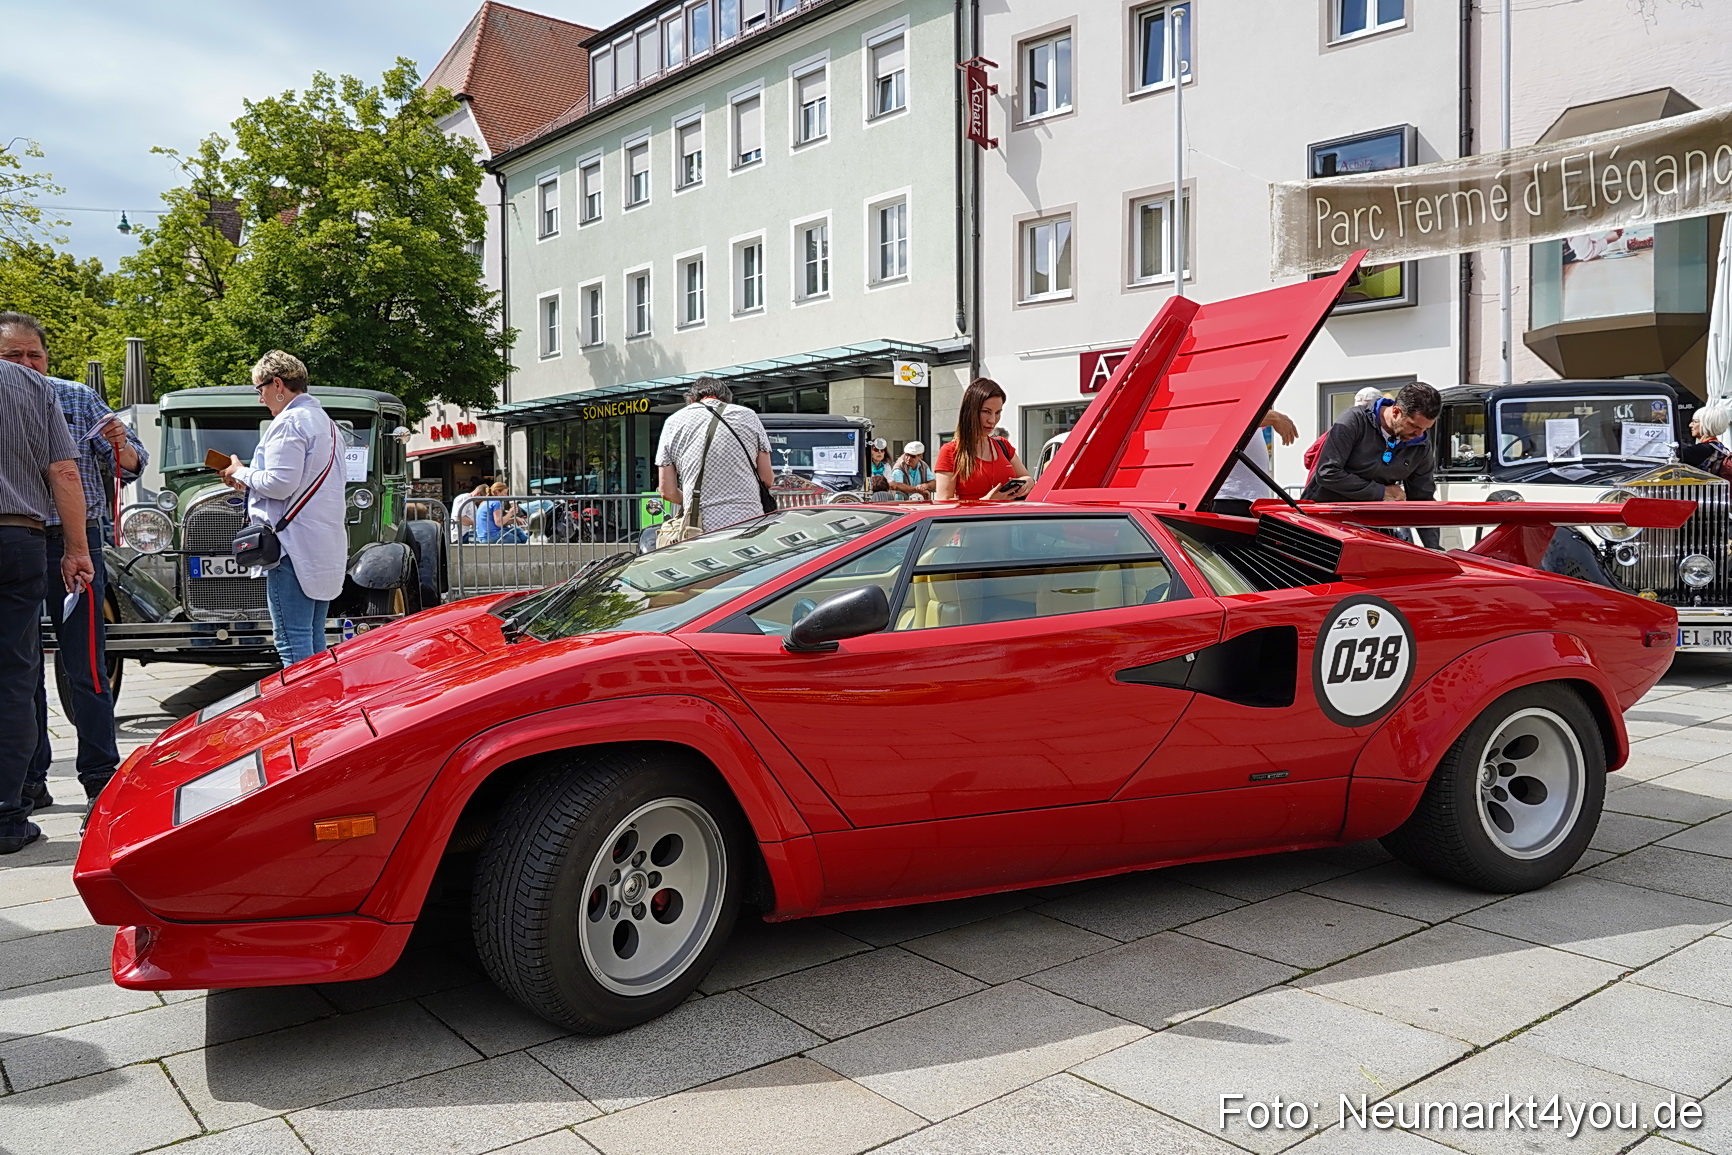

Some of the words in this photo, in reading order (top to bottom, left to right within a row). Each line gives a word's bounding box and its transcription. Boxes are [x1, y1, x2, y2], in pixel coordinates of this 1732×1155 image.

[972, 77, 984, 136] Achatz
[1340, 159, 1374, 170] Achatz
[1315, 197, 1385, 249] Parc
[1393, 169, 1509, 238] Fermé
[583, 398, 649, 420] SONNECHKO
[852, 405, 860, 414] 22
[832, 452, 847, 460] 447
[201, 559, 213, 575] R
[1681, 630, 1701, 646] EI
[1713, 630, 1732, 646] RR
[1327, 635, 1403, 684] 038
